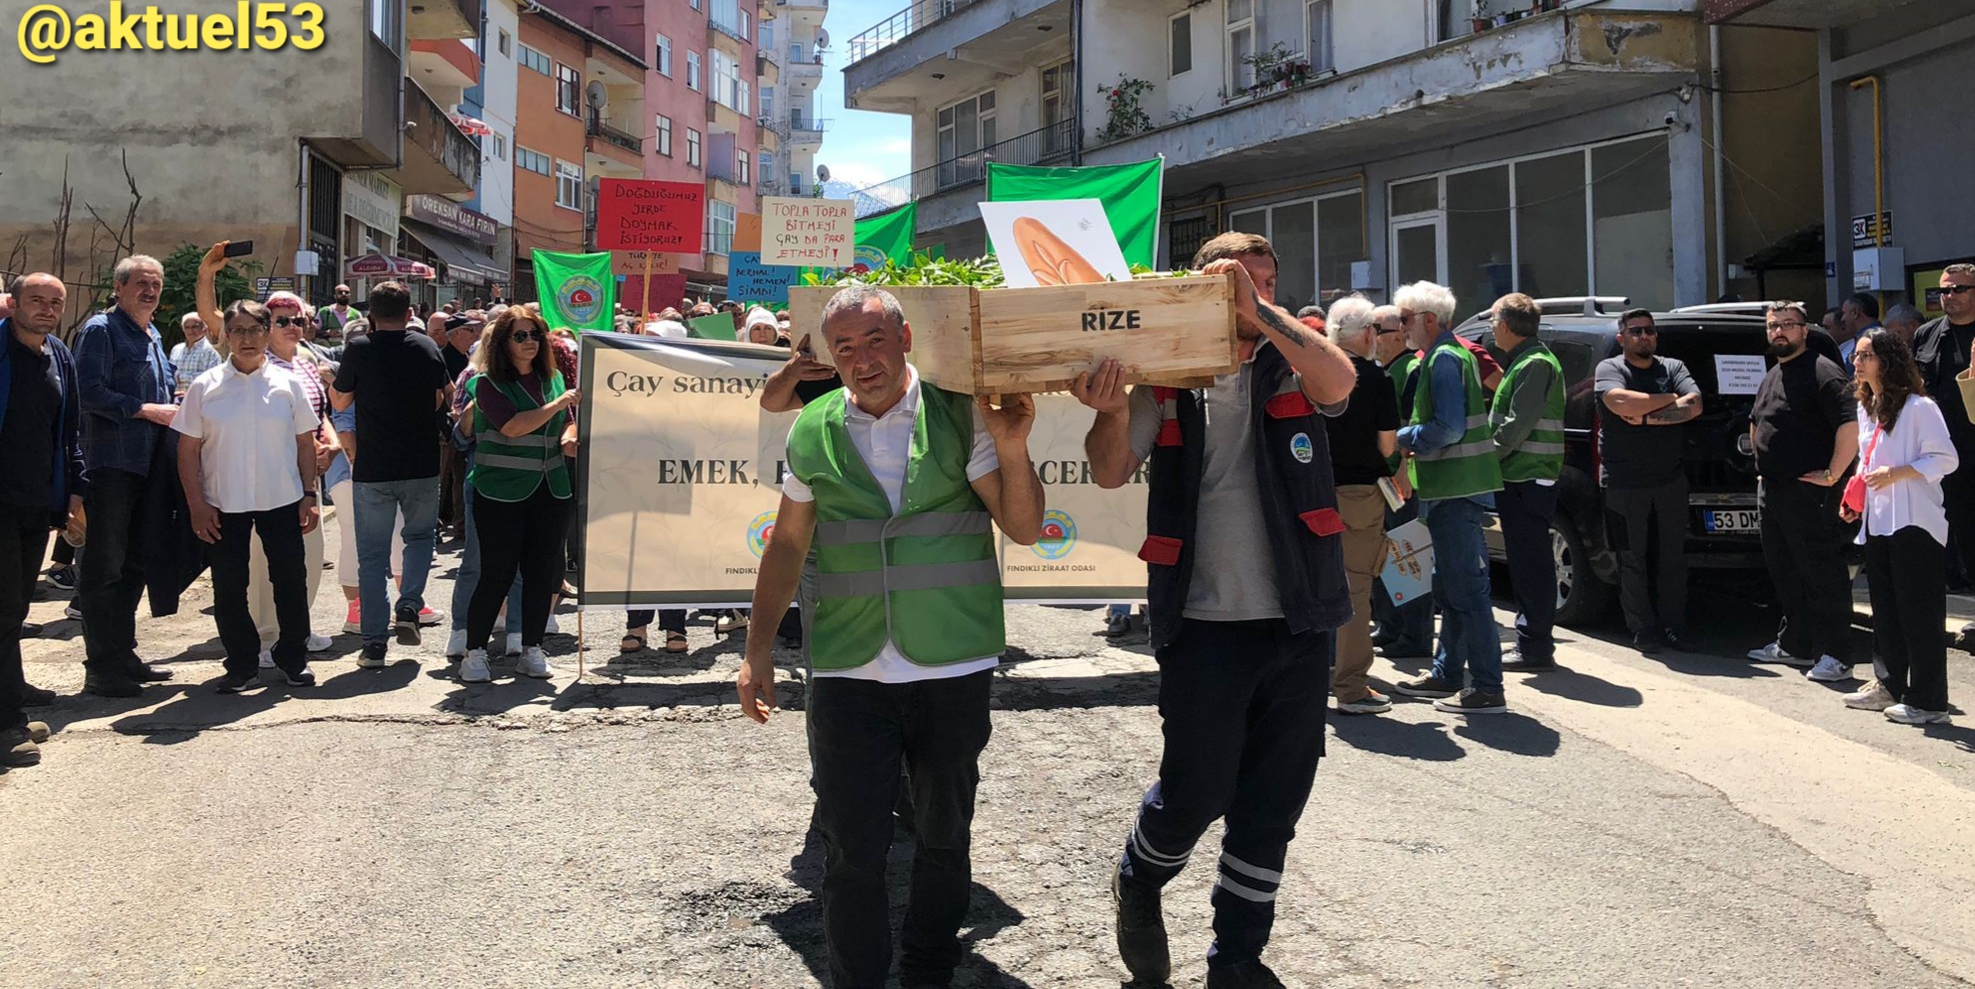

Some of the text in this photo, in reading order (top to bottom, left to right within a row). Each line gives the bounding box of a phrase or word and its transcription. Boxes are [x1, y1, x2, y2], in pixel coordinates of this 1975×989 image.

[632, 203, 667, 215] YERDE
[772, 202, 847, 218] TOPLA TOPLA
[458, 210, 476, 229] KARA
[620, 216, 678, 231] DOYMAK
[785, 219, 837, 232] BİTMEYİ
[775, 233, 845, 247] ÇAY DA PARA
[606, 370, 664, 398] Çay
[658, 459, 759, 489] EMEK,
[1714, 512, 1735, 529] 53
[725, 567, 760, 575] FINDIKL
[1041, 563, 1070, 572] ZİRAAT
[1071, 564, 1096, 572] ODASI
